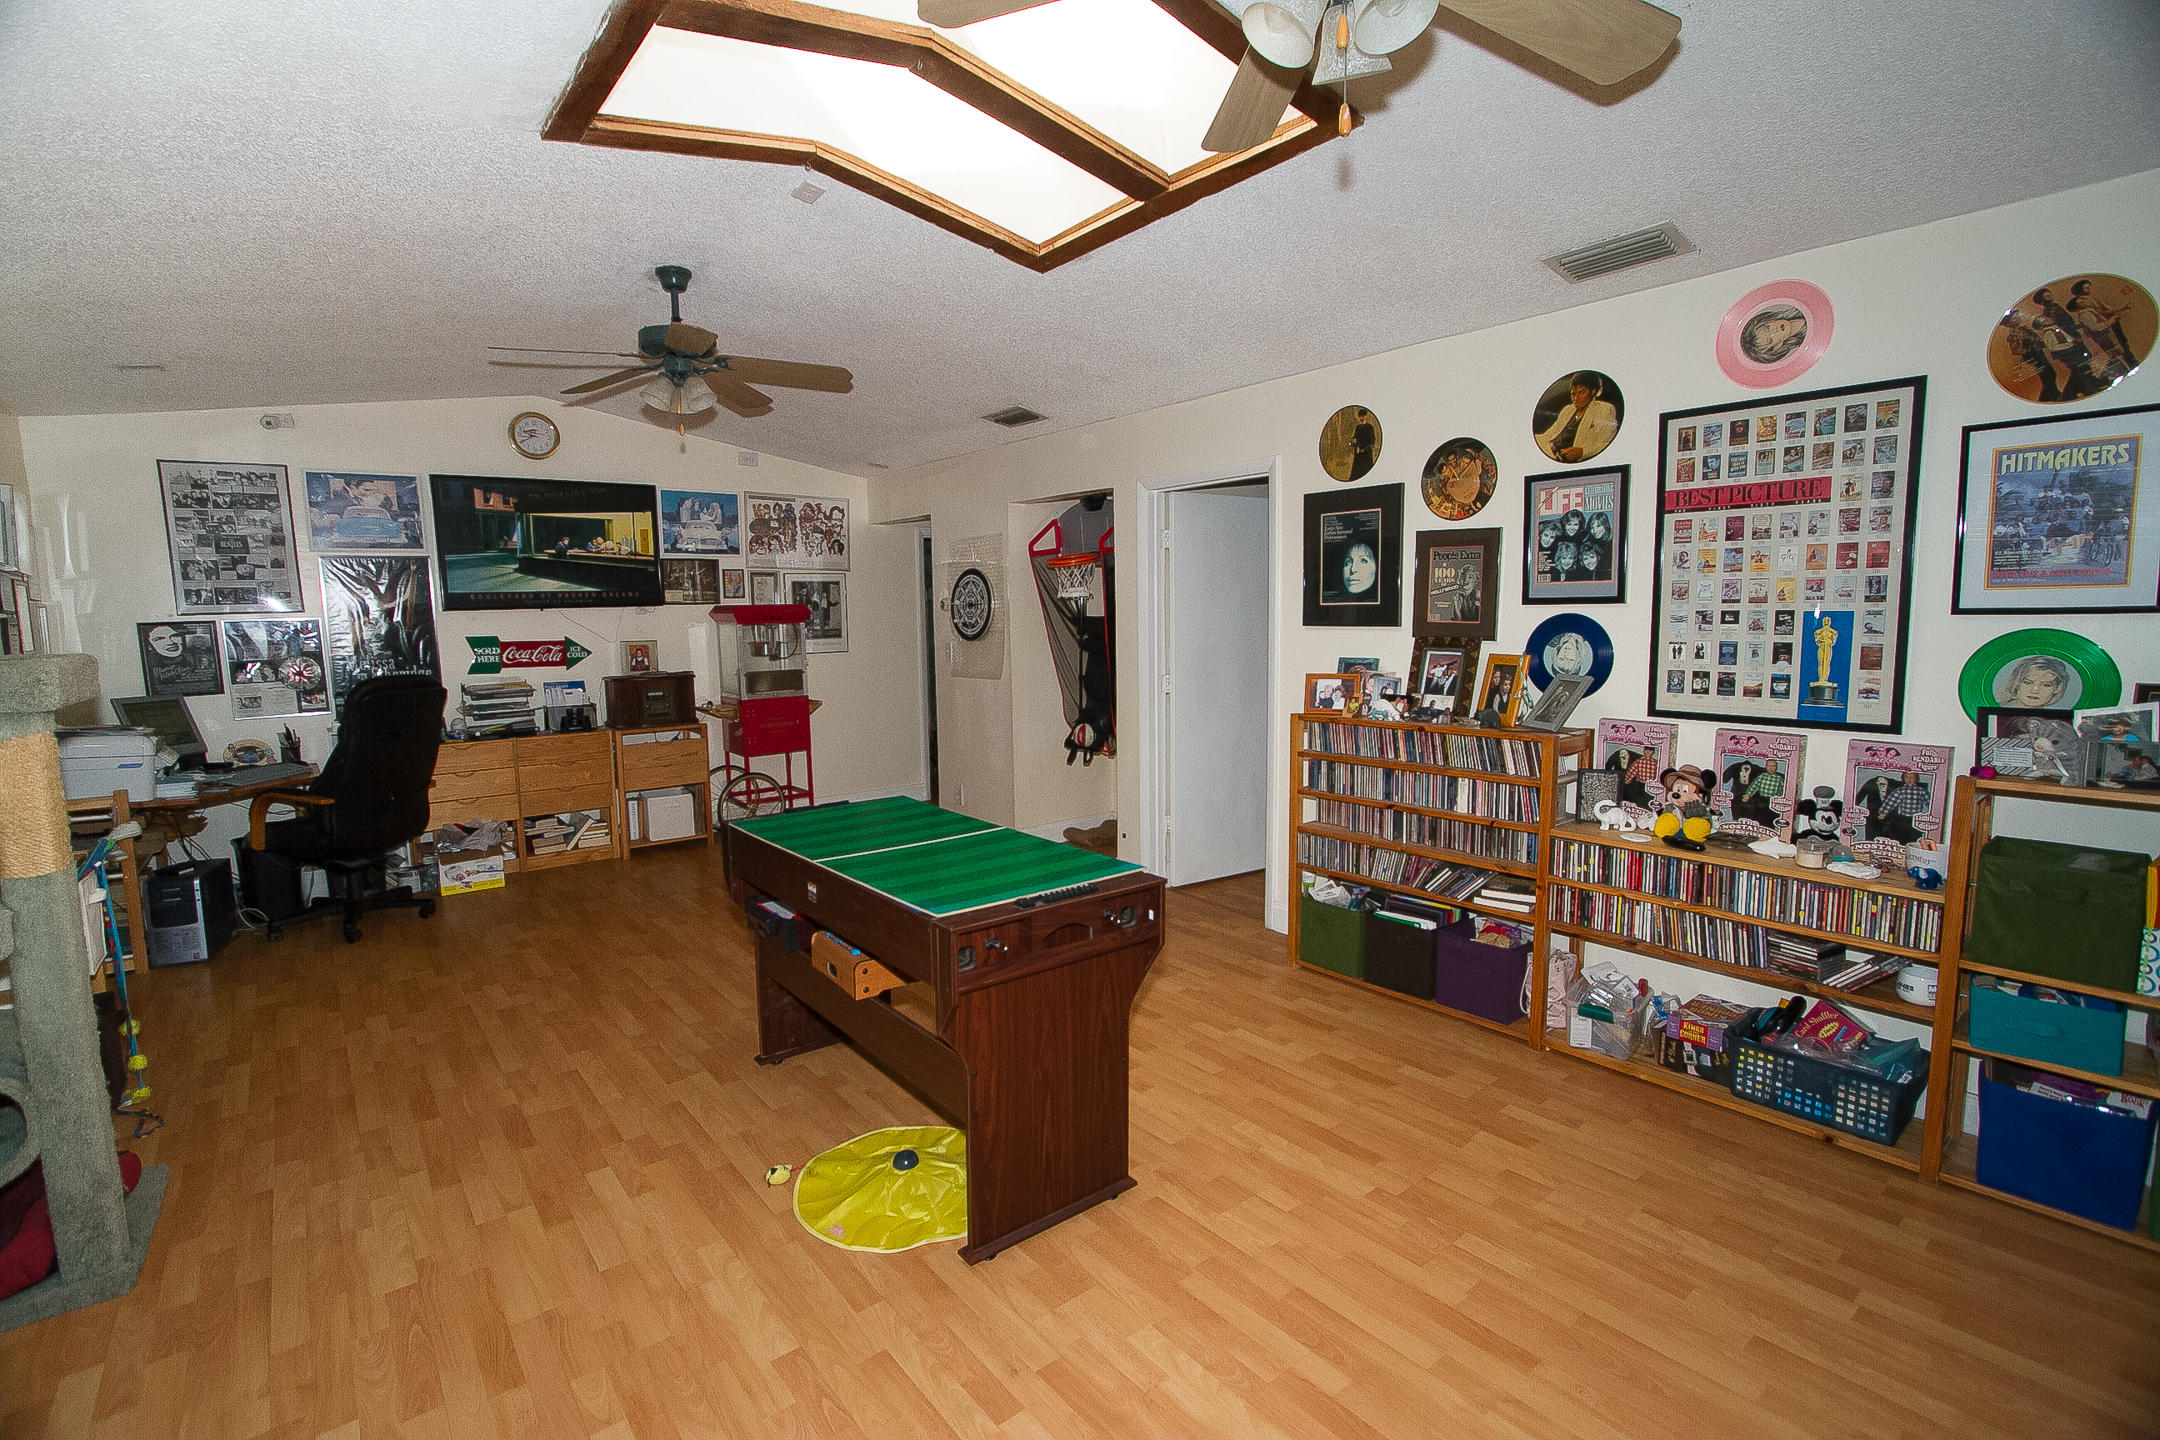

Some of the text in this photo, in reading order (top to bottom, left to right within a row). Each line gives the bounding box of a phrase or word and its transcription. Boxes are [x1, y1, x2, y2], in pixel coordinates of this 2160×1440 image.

[2001, 443, 2130, 476] HITMAKERS
[1674, 479, 1823, 507] BEST PICTURE
[1540, 487, 1584, 515] LIFE
[1433, 550, 1482, 561] People Extra
[1434, 567, 1456, 578] 100
[477, 655, 500, 663] HERE
[502, 645, 564, 664] Coca-Cola
[1915, 815, 1940, 823] Limited
[1722, 824, 1777, 837] NOSTALGIC
[1854, 844, 1906, 854] NOSTALG
[1683, 1021, 1705, 1034] KINGS
[1794, 1011, 1839, 1038] Card Shuffler
